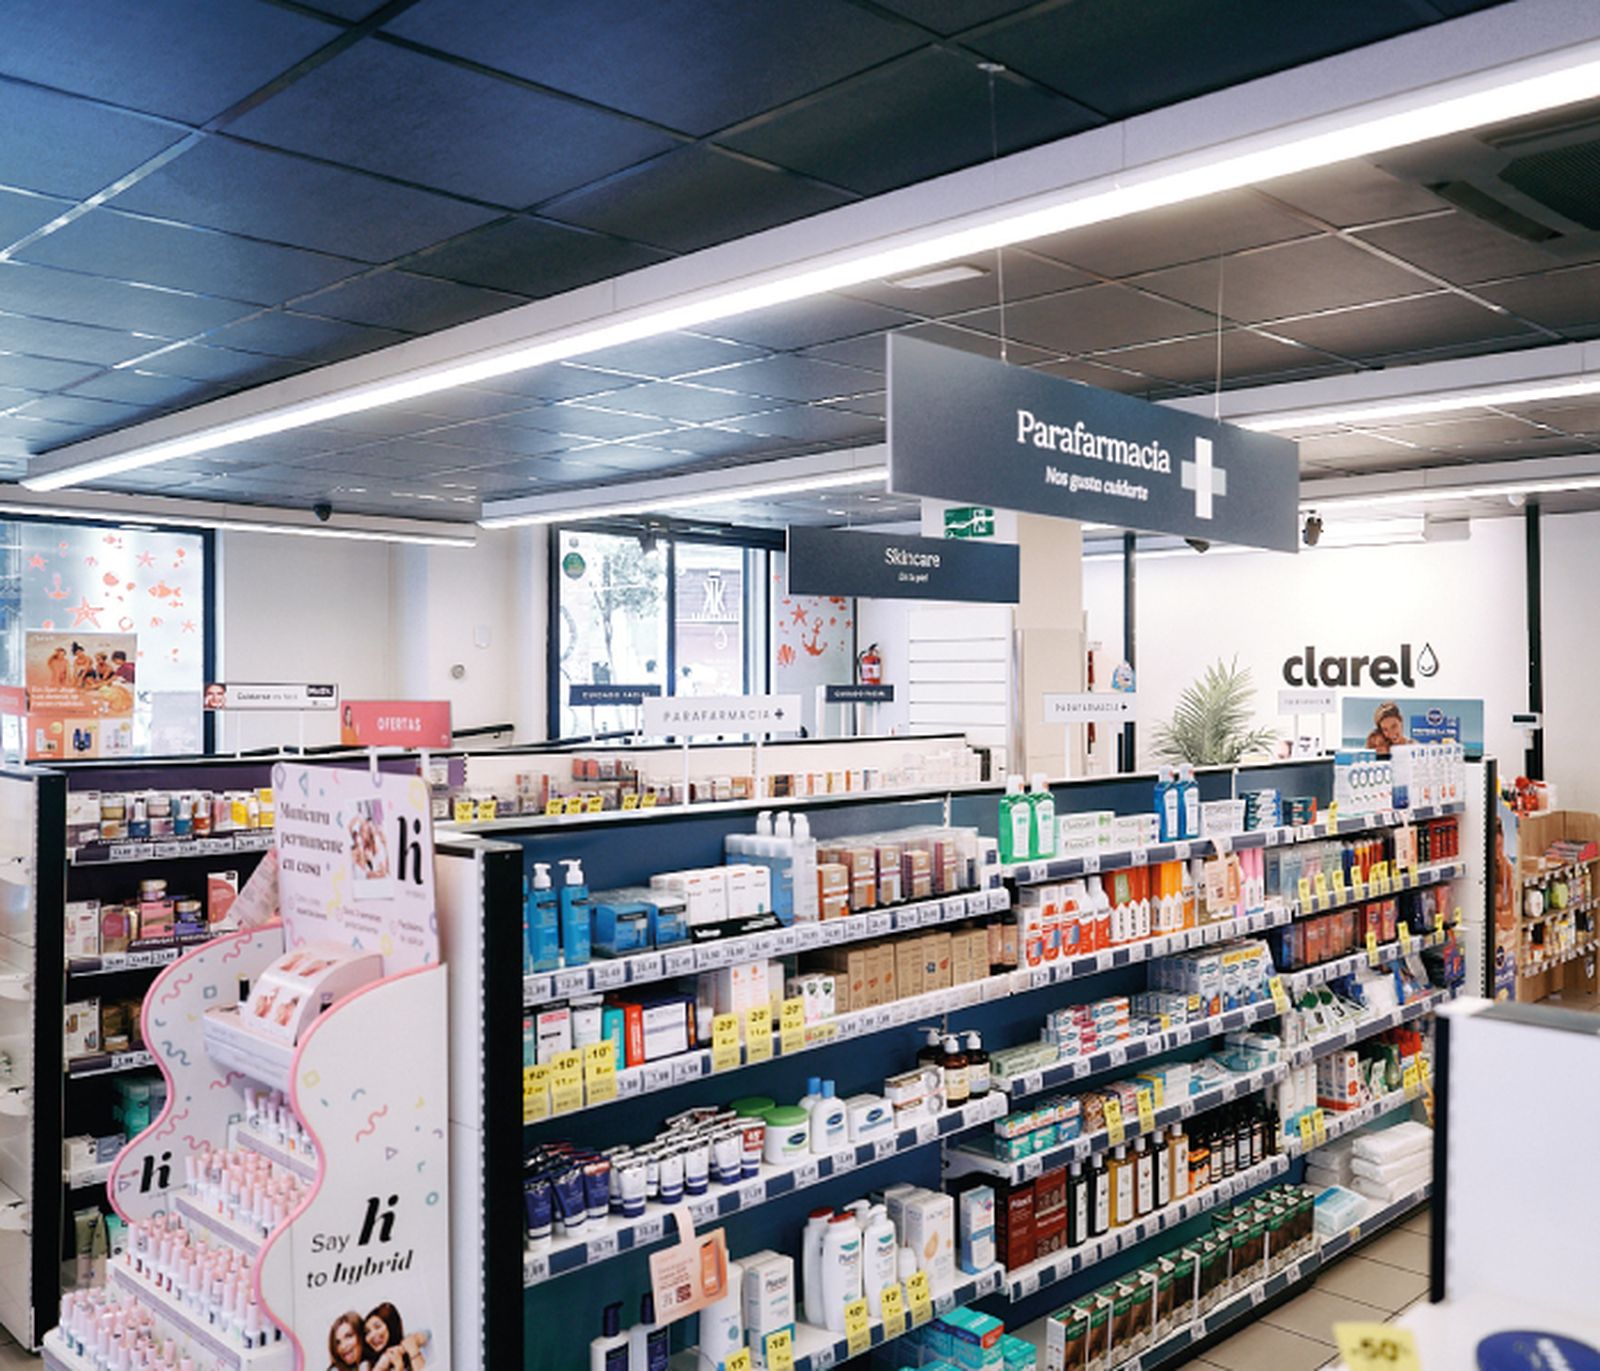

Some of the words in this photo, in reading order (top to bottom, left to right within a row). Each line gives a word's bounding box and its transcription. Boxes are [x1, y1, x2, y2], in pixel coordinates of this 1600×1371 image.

[1017, 410, 1171, 473] Parafarmacia
[1045, 466, 1069, 486] Nos
[885, 547, 940, 568] Skincare
[1283, 644, 1415, 688] clarel
[376, 717, 421, 732] OFERTAS
[663, 709, 770, 723] PARAFARMACIA
[280, 802, 330, 825] Manicura
[281, 832, 343, 854] permanente
[283, 858, 295, 871] en
[297, 862, 321, 876] casa
[311, 1233, 350, 1254] Say
[358, 1194, 399, 1247] hi
[306, 1272, 328, 1288] to
[333, 1249, 413, 1286] hybrid
